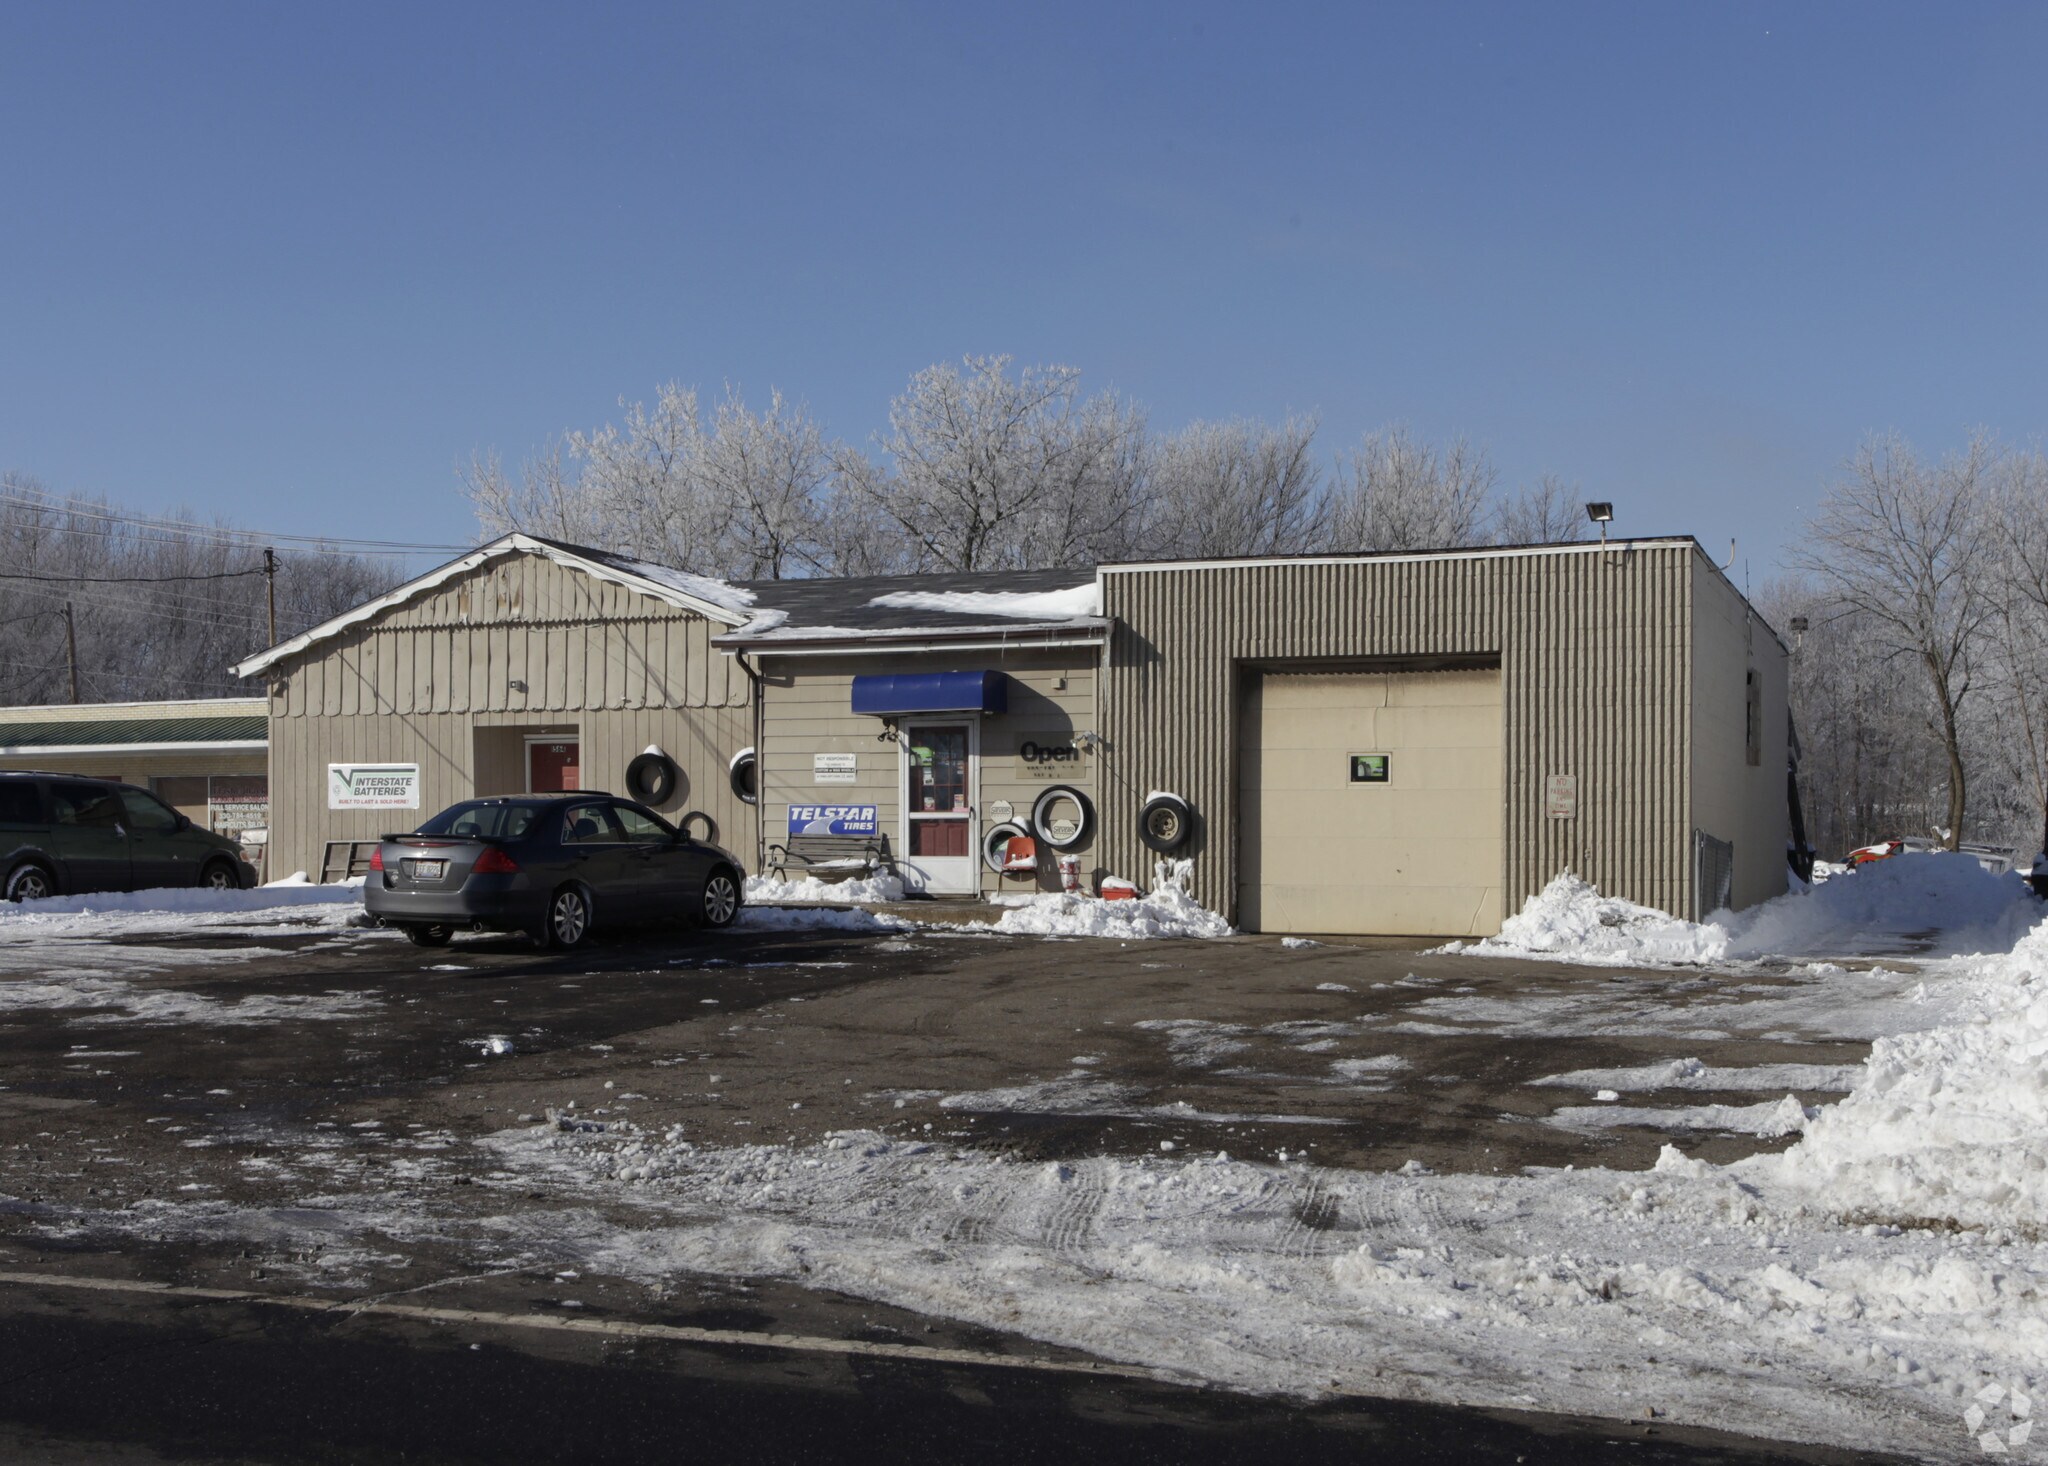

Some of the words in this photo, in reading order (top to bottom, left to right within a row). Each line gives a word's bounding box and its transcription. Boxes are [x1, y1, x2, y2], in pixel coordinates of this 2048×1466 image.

[1021, 741, 1079, 765] Open
[355, 777, 412, 787] INTERSTATE
[1556, 777, 1567, 786] NO
[354, 787, 406, 796] BATTERIES
[225, 803, 249, 811] SERVICE
[791, 807, 874, 821] TELSTAR
[214, 821, 247, 829] HAIRCUTS
[843, 822, 874, 831] TIRES
